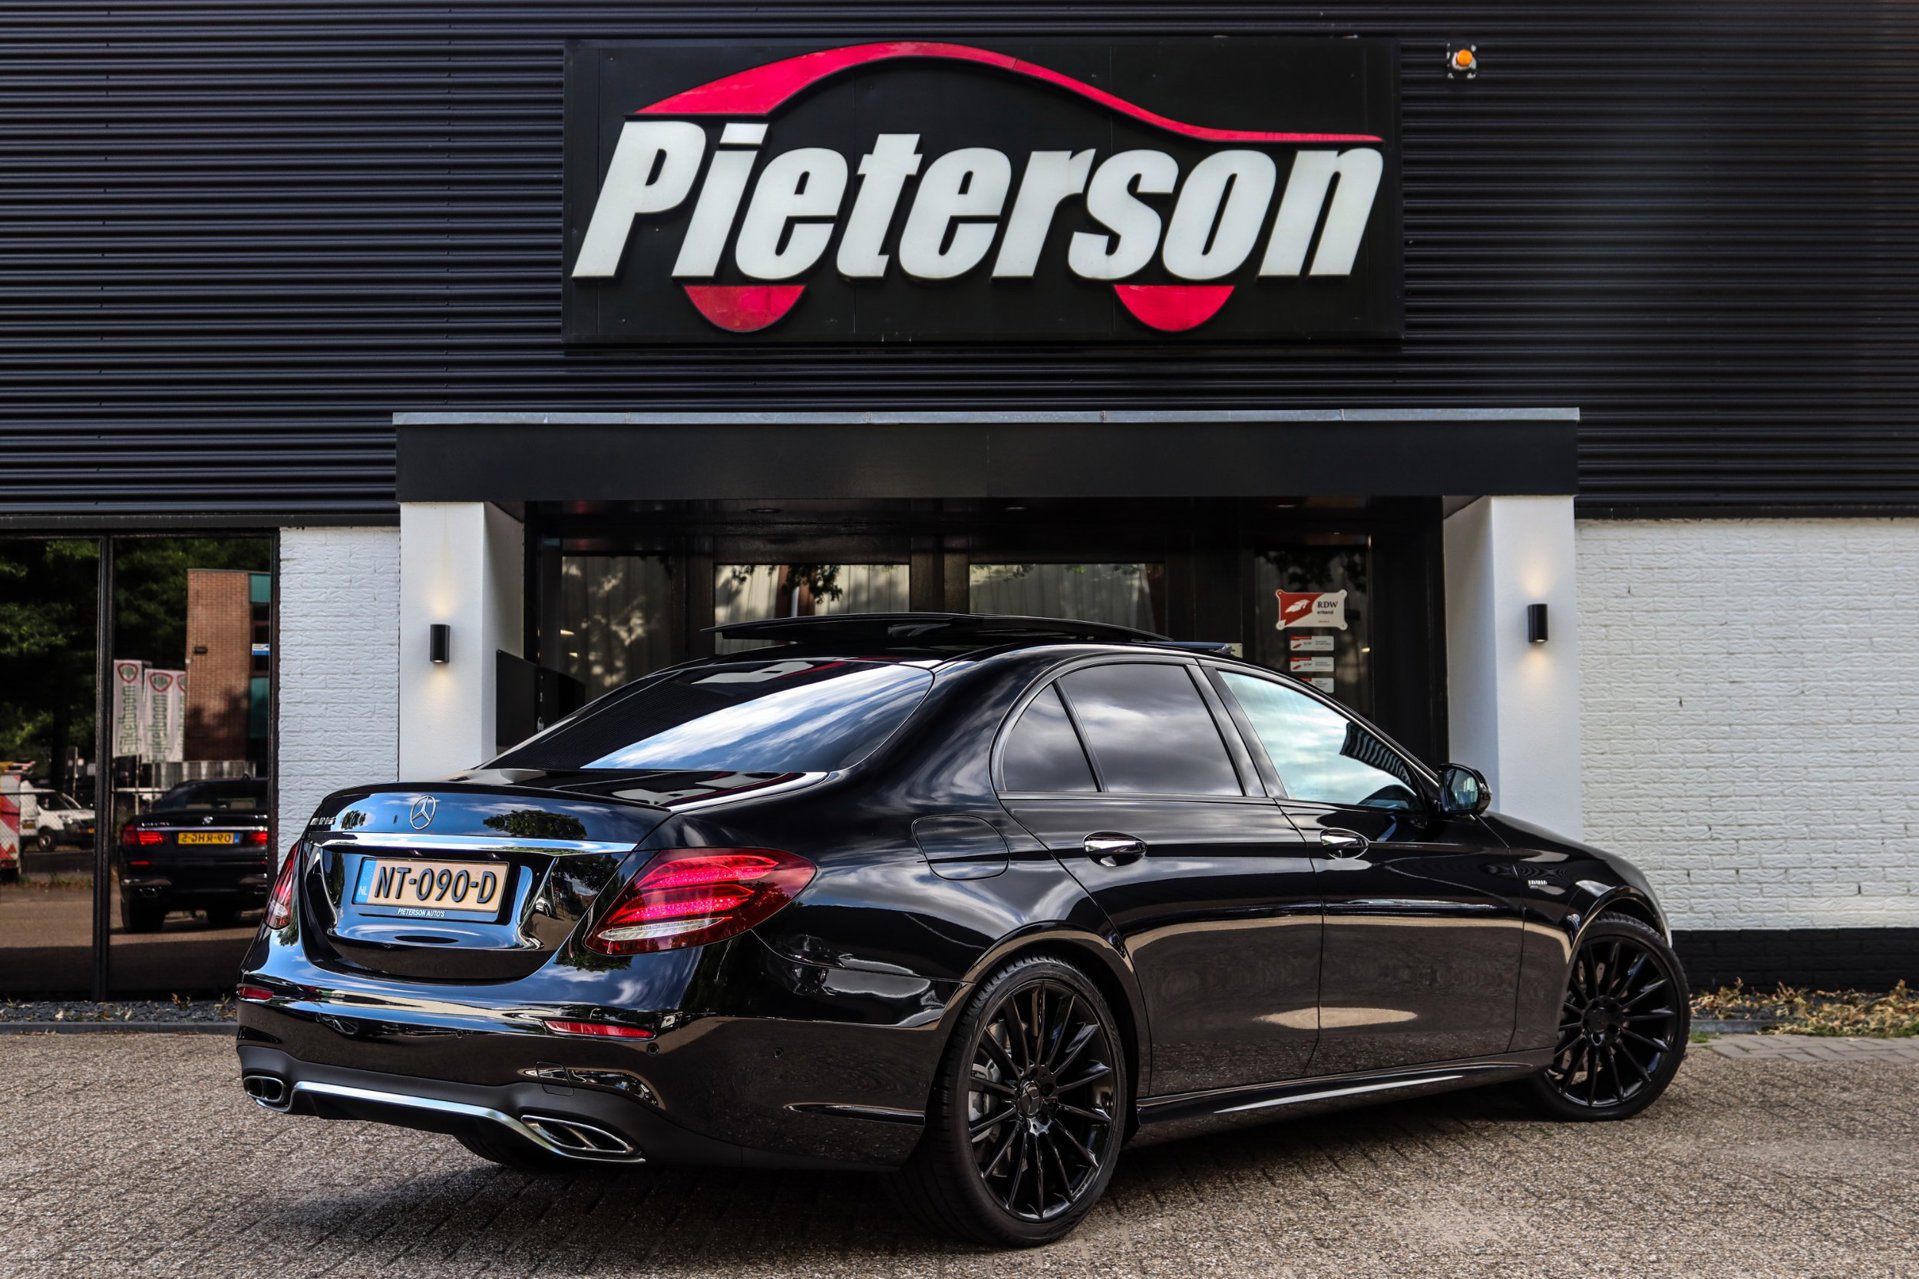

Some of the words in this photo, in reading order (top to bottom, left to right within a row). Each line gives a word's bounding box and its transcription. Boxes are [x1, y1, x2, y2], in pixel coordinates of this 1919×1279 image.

[571, 121, 1384, 282] Pieterson
[1317, 600, 1338, 609] RDW
[374, 866, 497, 904] NT-090-D
[358, 886, 367, 895] NL
[397, 908, 426, 917] PIETERSON
[426, 909, 446, 918] AUTO'S
